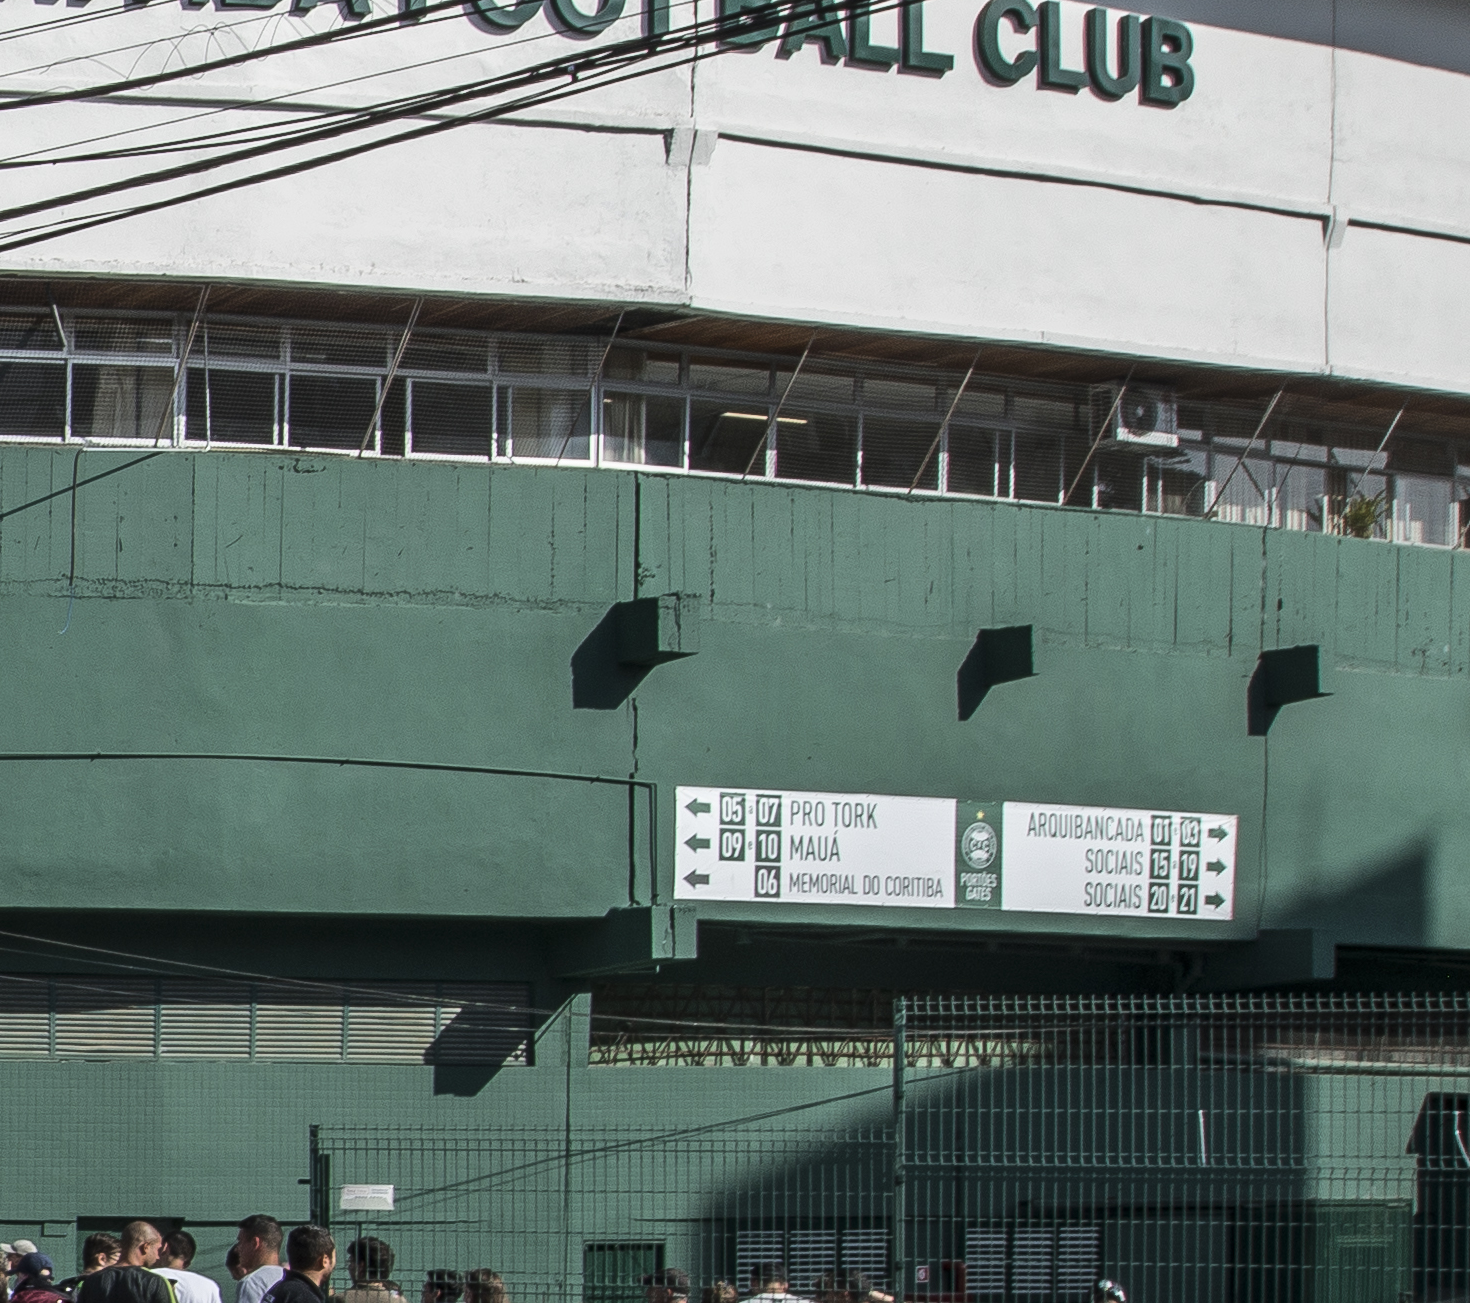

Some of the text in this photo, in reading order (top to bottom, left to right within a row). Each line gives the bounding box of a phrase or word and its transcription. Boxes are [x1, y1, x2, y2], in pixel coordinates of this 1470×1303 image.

[720, 796, 742, 823] 05
[758, 797, 781, 824] 07
[790, 800, 826, 827] PRO
[831, 802, 878, 829] TORK
[1026, 812, 1145, 843] ARQUIBANCADA
[1152, 817, 1171, 845] 01
[1181, 820, 1200, 846] 03
[721, 831, 741, 858] 09
[758, 833, 779, 860] 10
[789, 830, 841, 862] MAUÁ
[1085, 848, 1143, 875] SOCIAIS
[1151, 851, 1169, 877] 15
[1180, 853, 1198, 879] 19
[757, 868, 944, 897] 06 MEMORIAL DO CORITIBA
[966, 887, 992, 901] GATES
[1083, 882, 1142, 909] SOCIAIS
[1150, 884, 1168, 911] 20
[1179, 886, 1196, 912] 21
